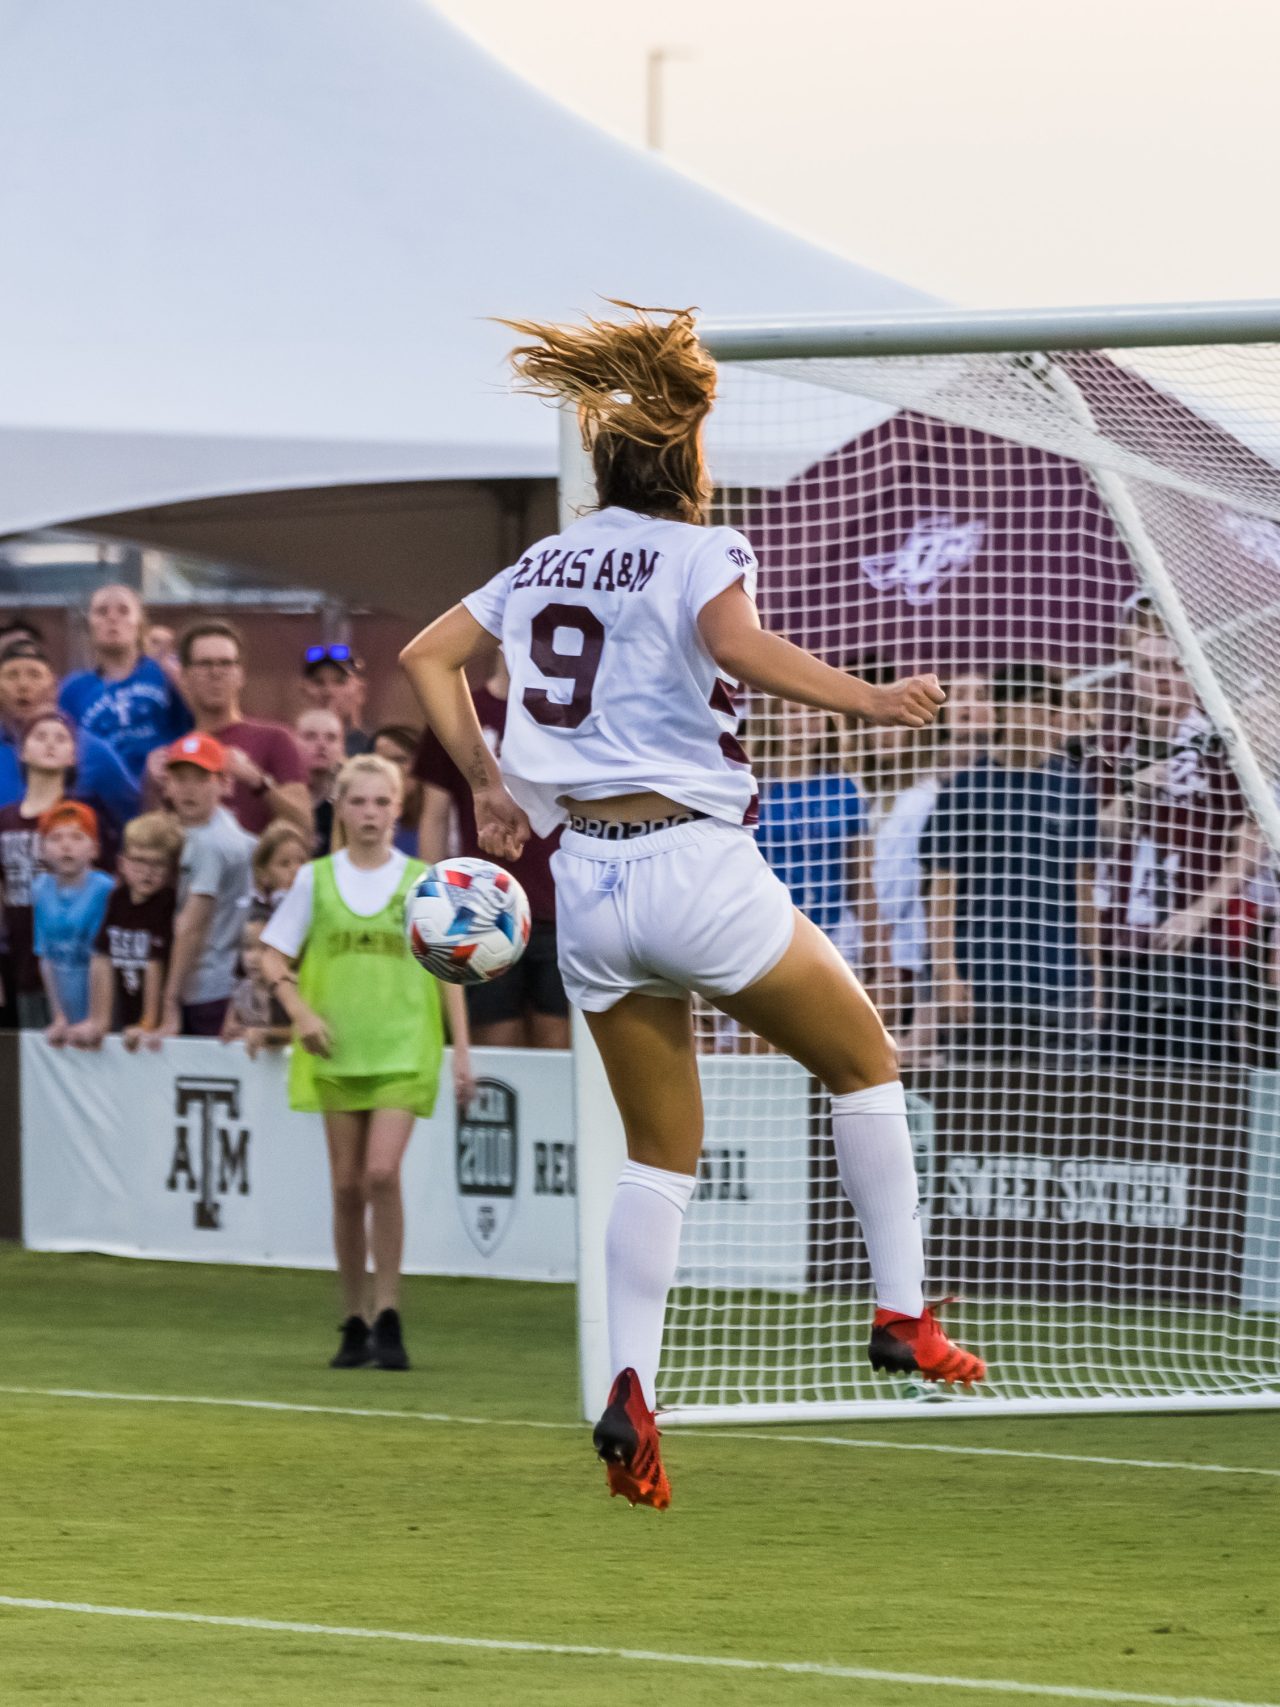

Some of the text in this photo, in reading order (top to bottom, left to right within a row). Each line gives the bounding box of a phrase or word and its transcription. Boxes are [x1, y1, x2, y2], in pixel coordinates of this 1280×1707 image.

[593, 548, 660, 593] A&M
[522, 603, 605, 729] 9
[949, 1156, 1188, 1227] SWEET SIXTEEN
